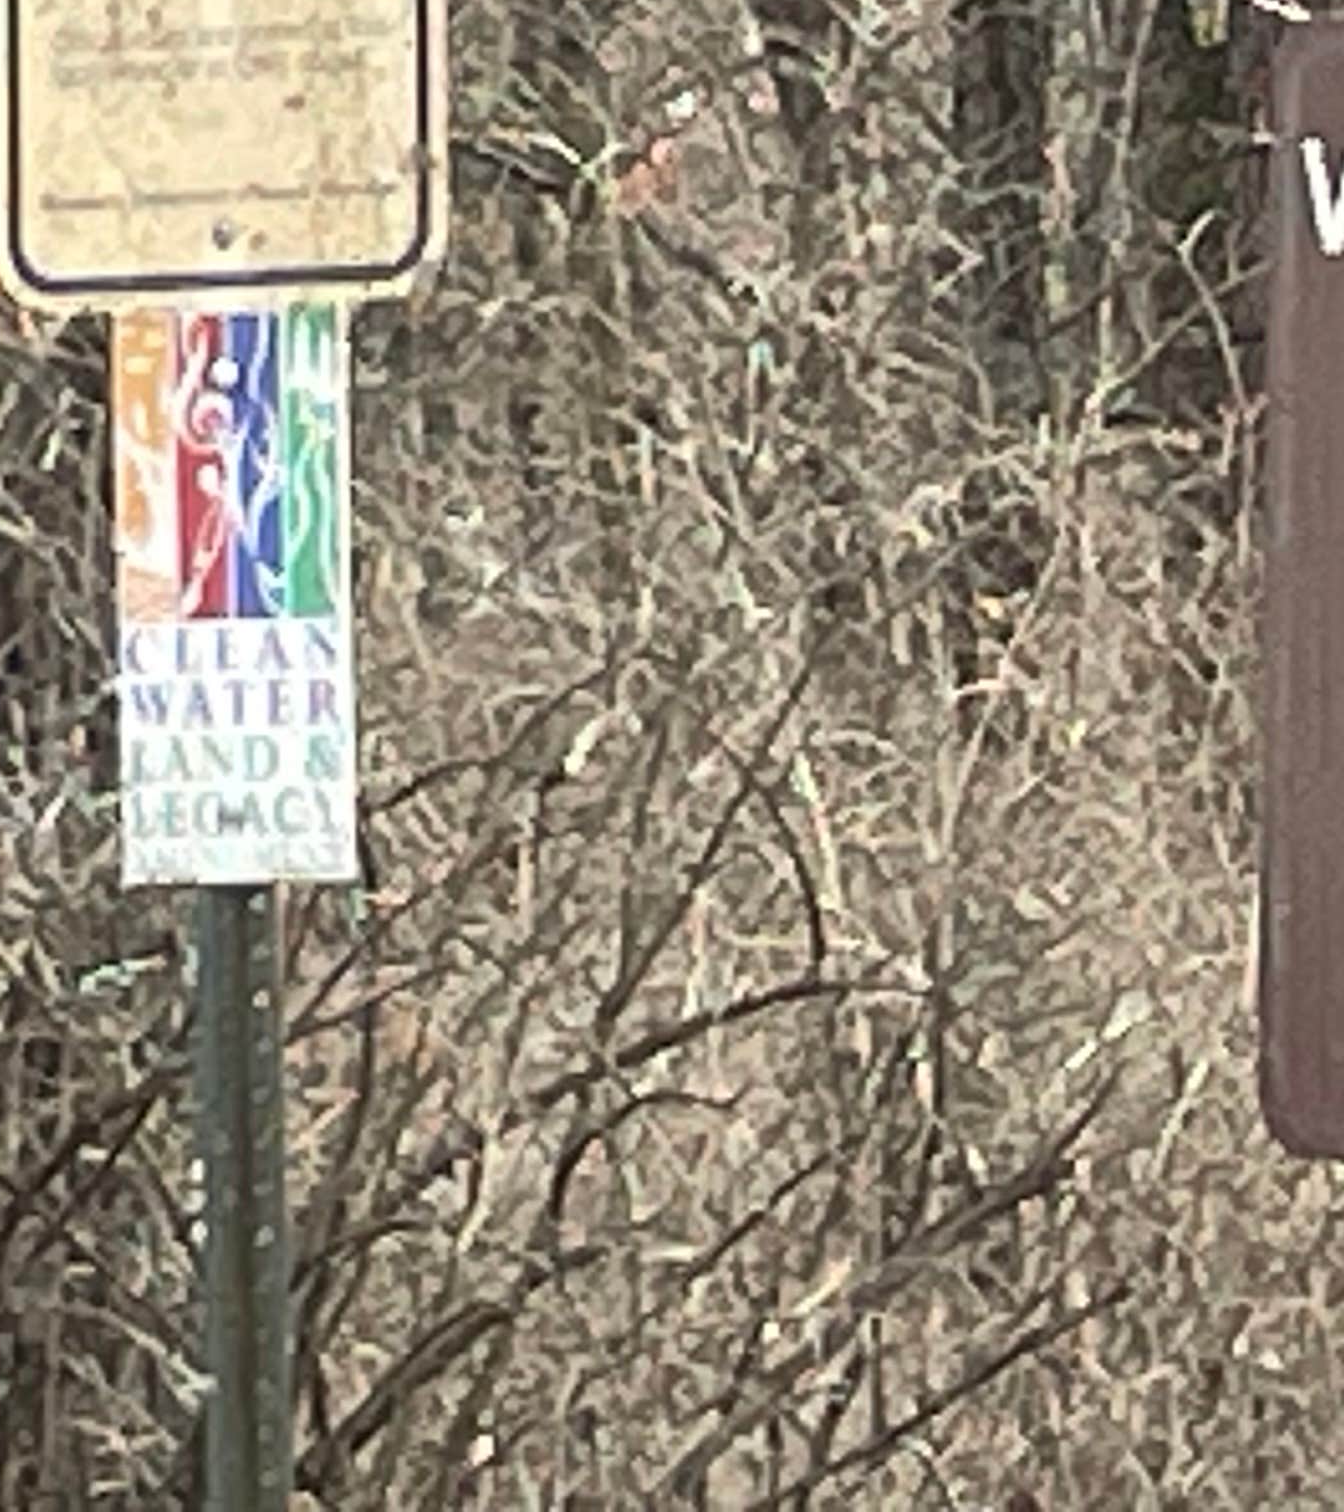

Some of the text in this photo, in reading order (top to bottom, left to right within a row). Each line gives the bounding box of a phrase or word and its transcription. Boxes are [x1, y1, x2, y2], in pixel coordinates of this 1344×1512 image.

[124, 623, 338, 675] CLEAN
[130, 678, 341, 728] WATER
[130, 735, 281, 782] LAND
